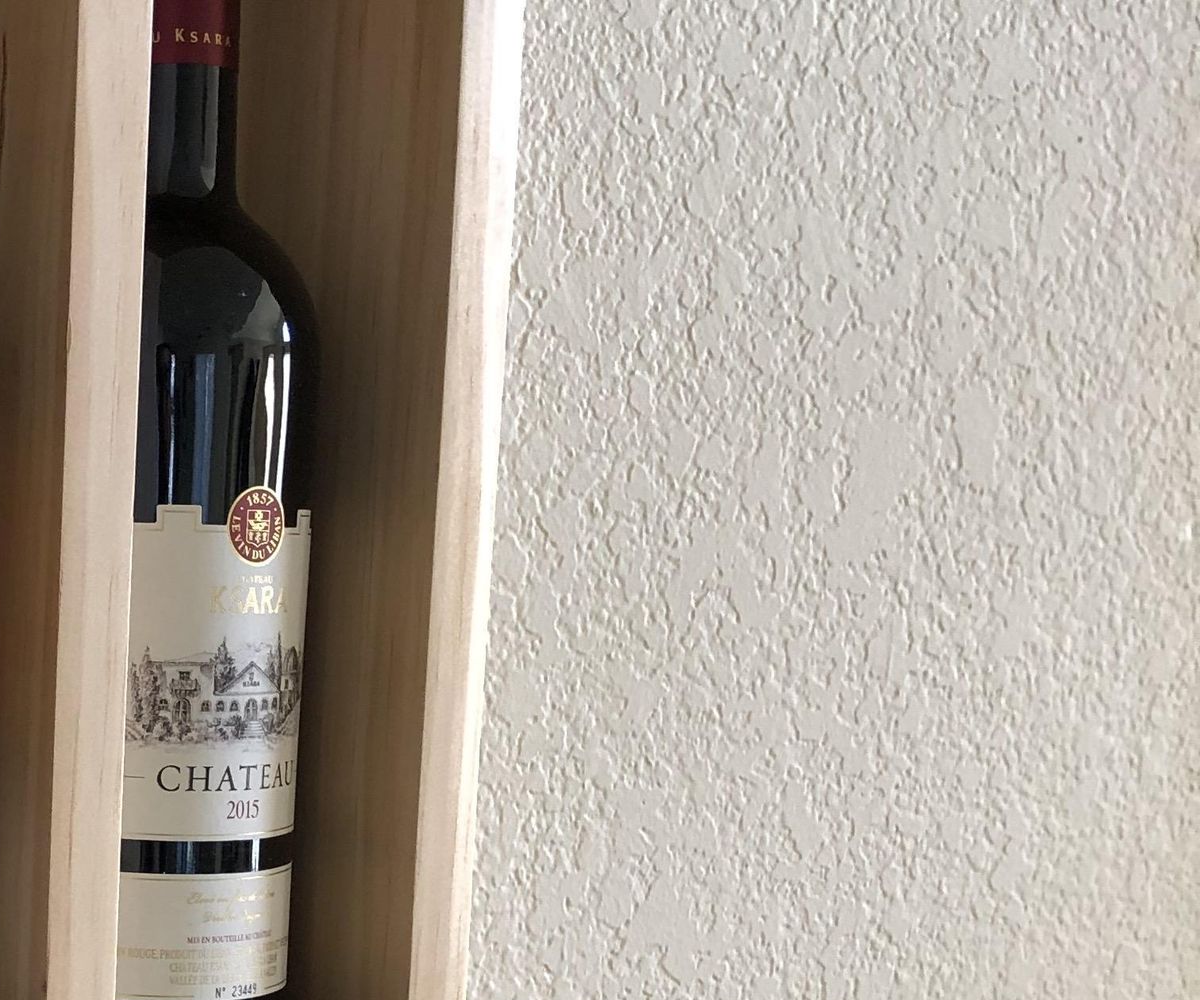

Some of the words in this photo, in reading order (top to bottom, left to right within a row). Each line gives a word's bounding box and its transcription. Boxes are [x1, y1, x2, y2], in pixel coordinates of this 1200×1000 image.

[174, 27, 231, 48] KSARA
[246, 492, 274, 507] 1857
[231, 515, 241, 533] LE
[234, 533, 252, 557] VIN
[265, 516, 282, 554] LIBAN
[251, 549, 266, 560] DU
[156, 759, 295, 793] CHATEAU
[226, 799, 260, 820] 2015
[231, 983, 257, 998] 23449
